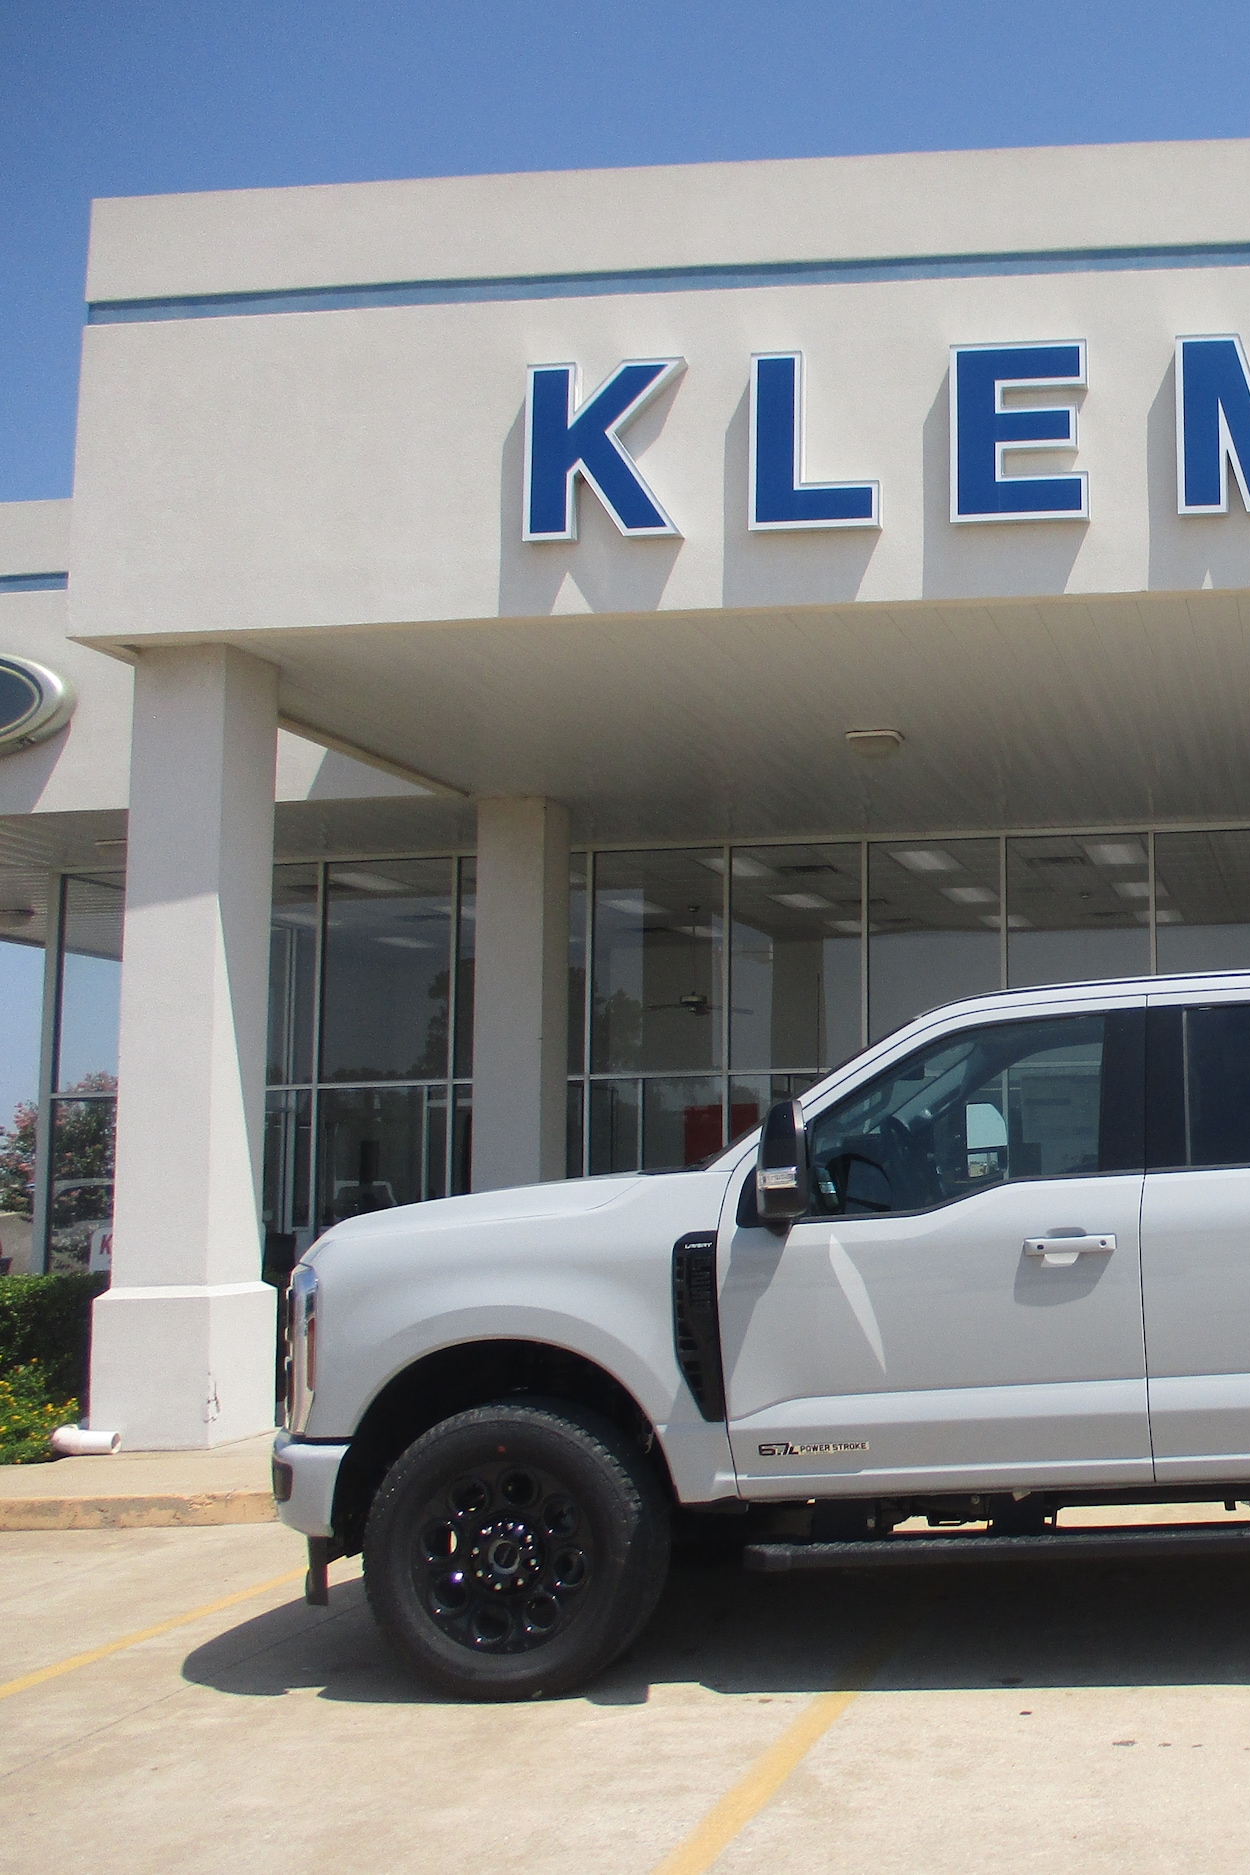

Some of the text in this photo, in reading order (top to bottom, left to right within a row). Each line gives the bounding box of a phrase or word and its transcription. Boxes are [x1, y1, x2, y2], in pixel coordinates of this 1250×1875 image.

[758, 1442, 867, 1456] 6.7L POWER STROKE
